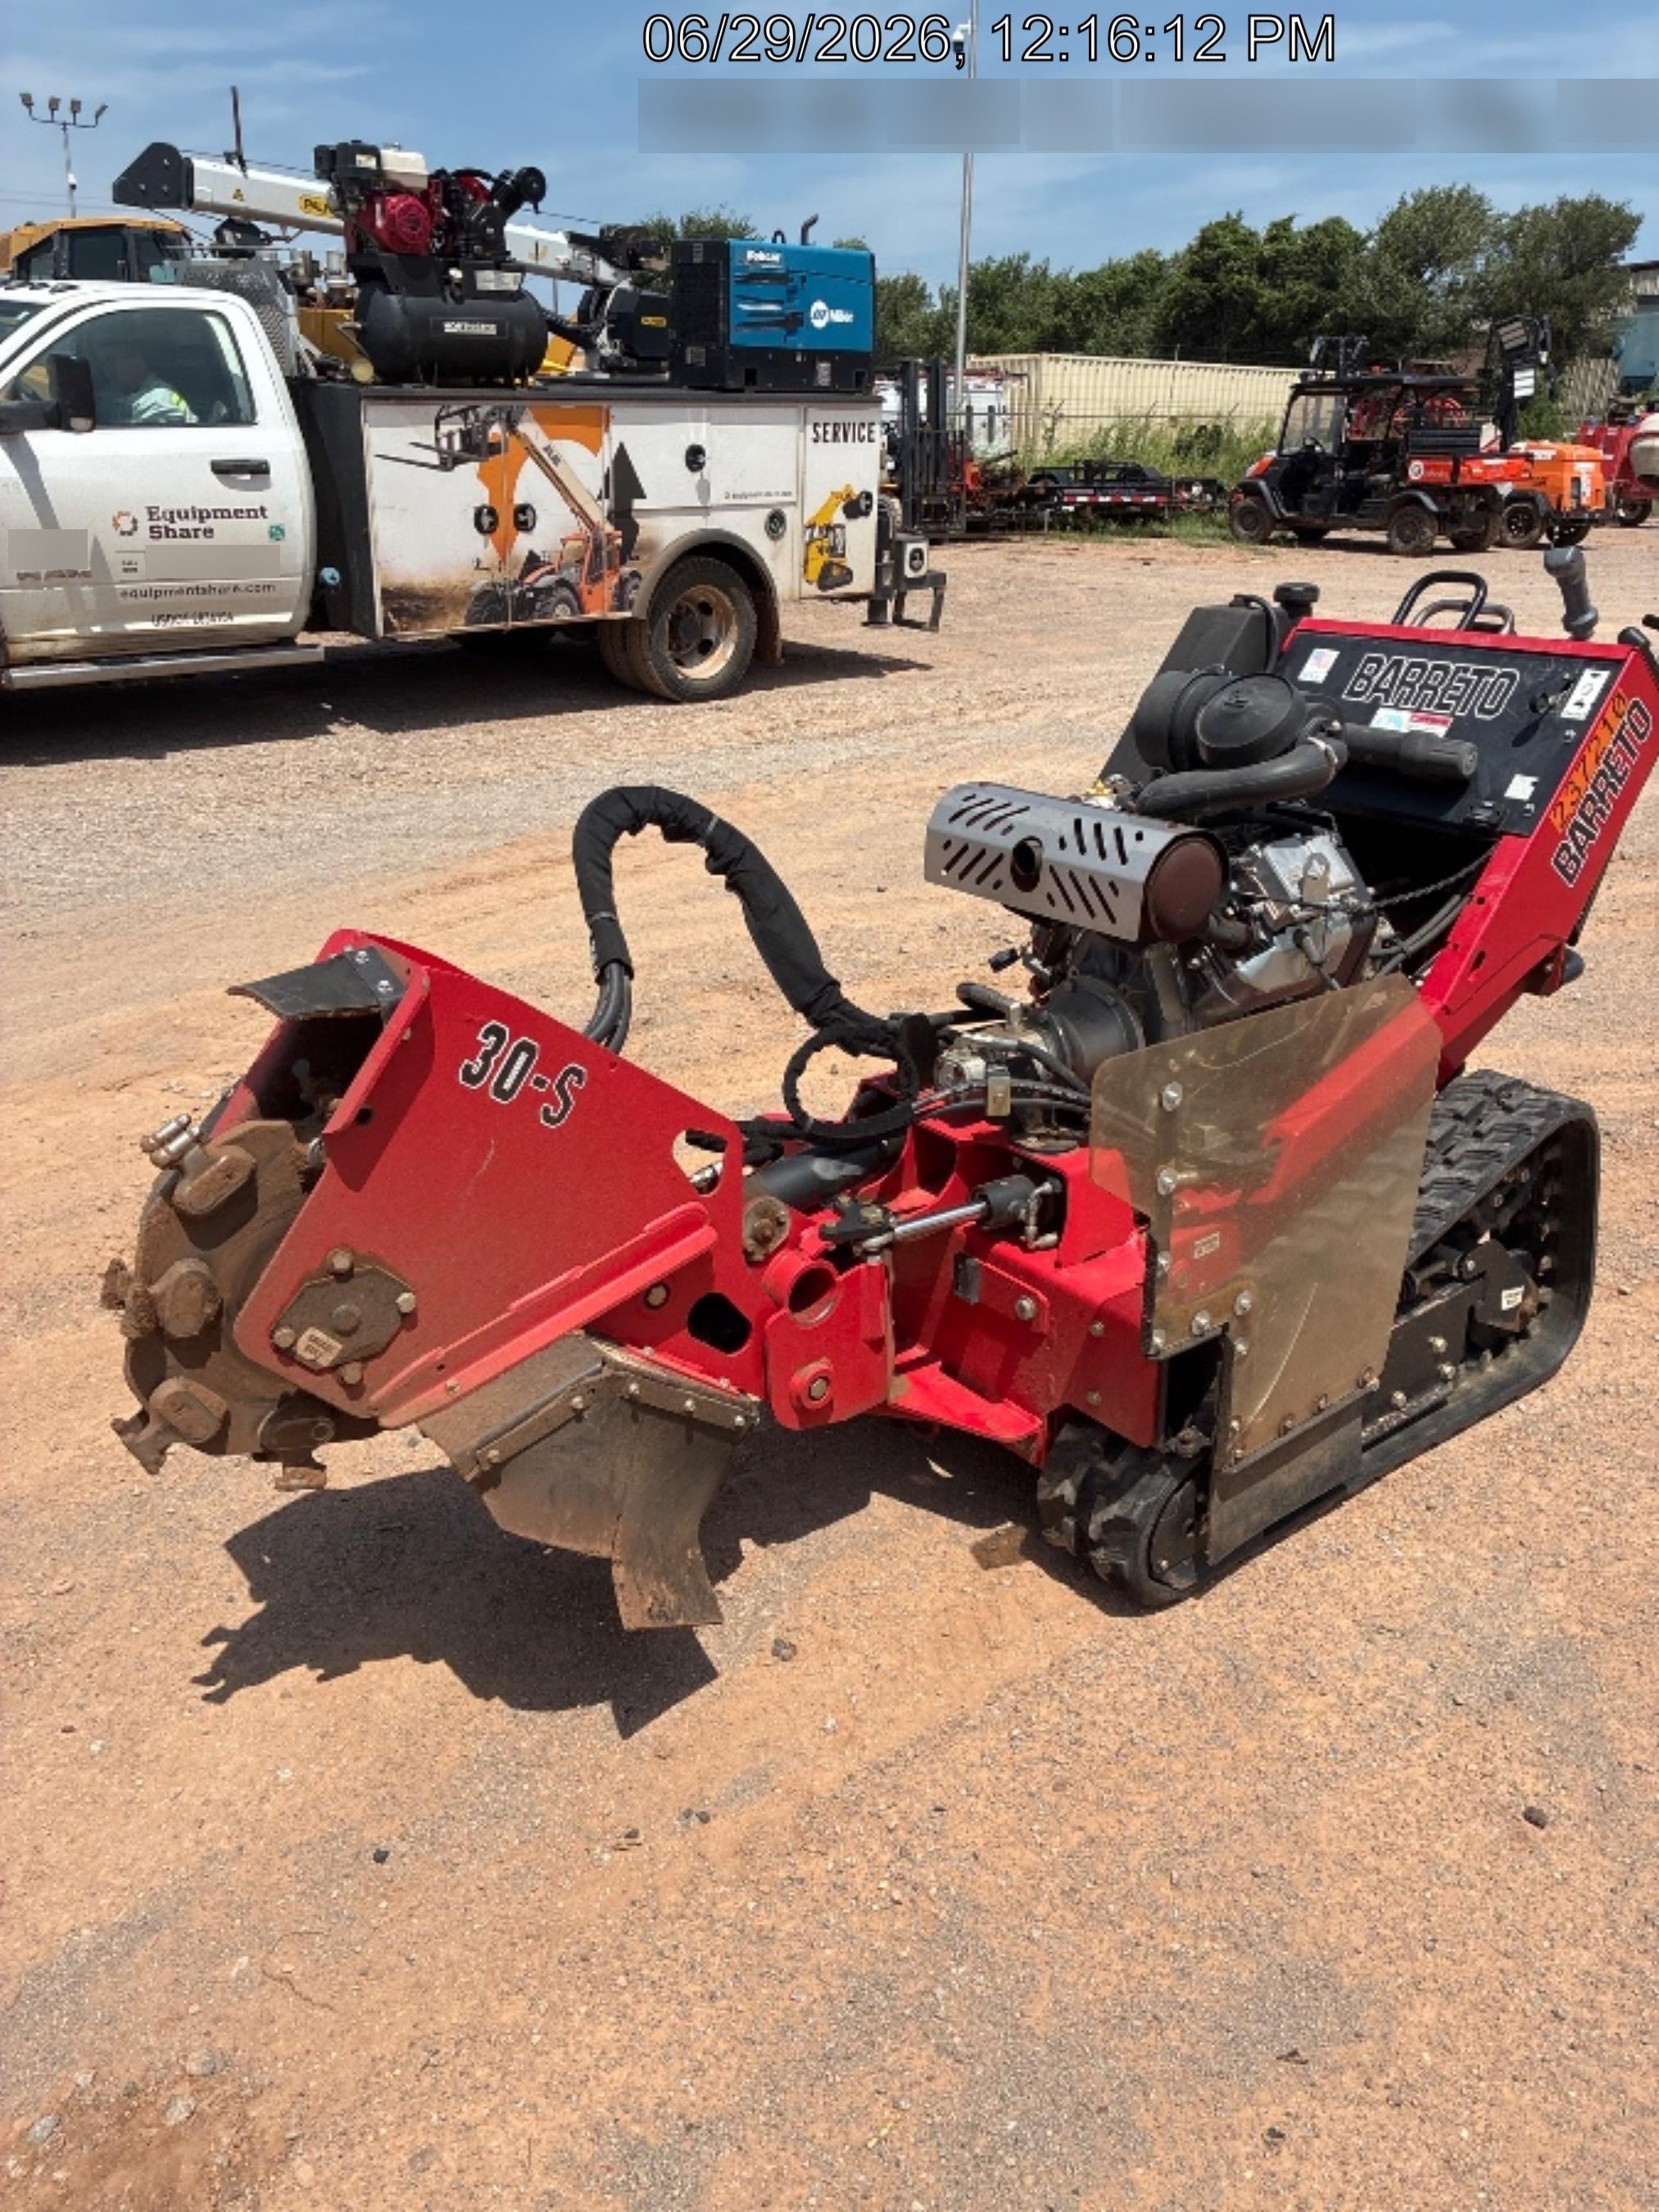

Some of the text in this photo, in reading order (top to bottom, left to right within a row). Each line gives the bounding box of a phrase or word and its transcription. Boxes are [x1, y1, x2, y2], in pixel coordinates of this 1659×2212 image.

[812, 422, 876, 443] SERVICE
[145, 505, 269, 524] Equipment
[148, 525, 215, 540] Share
[1341, 652, 1520, 721] BARRETO
[1551, 697, 1653, 889] BARRETO
[459, 1020, 587, 1129] 30-S
